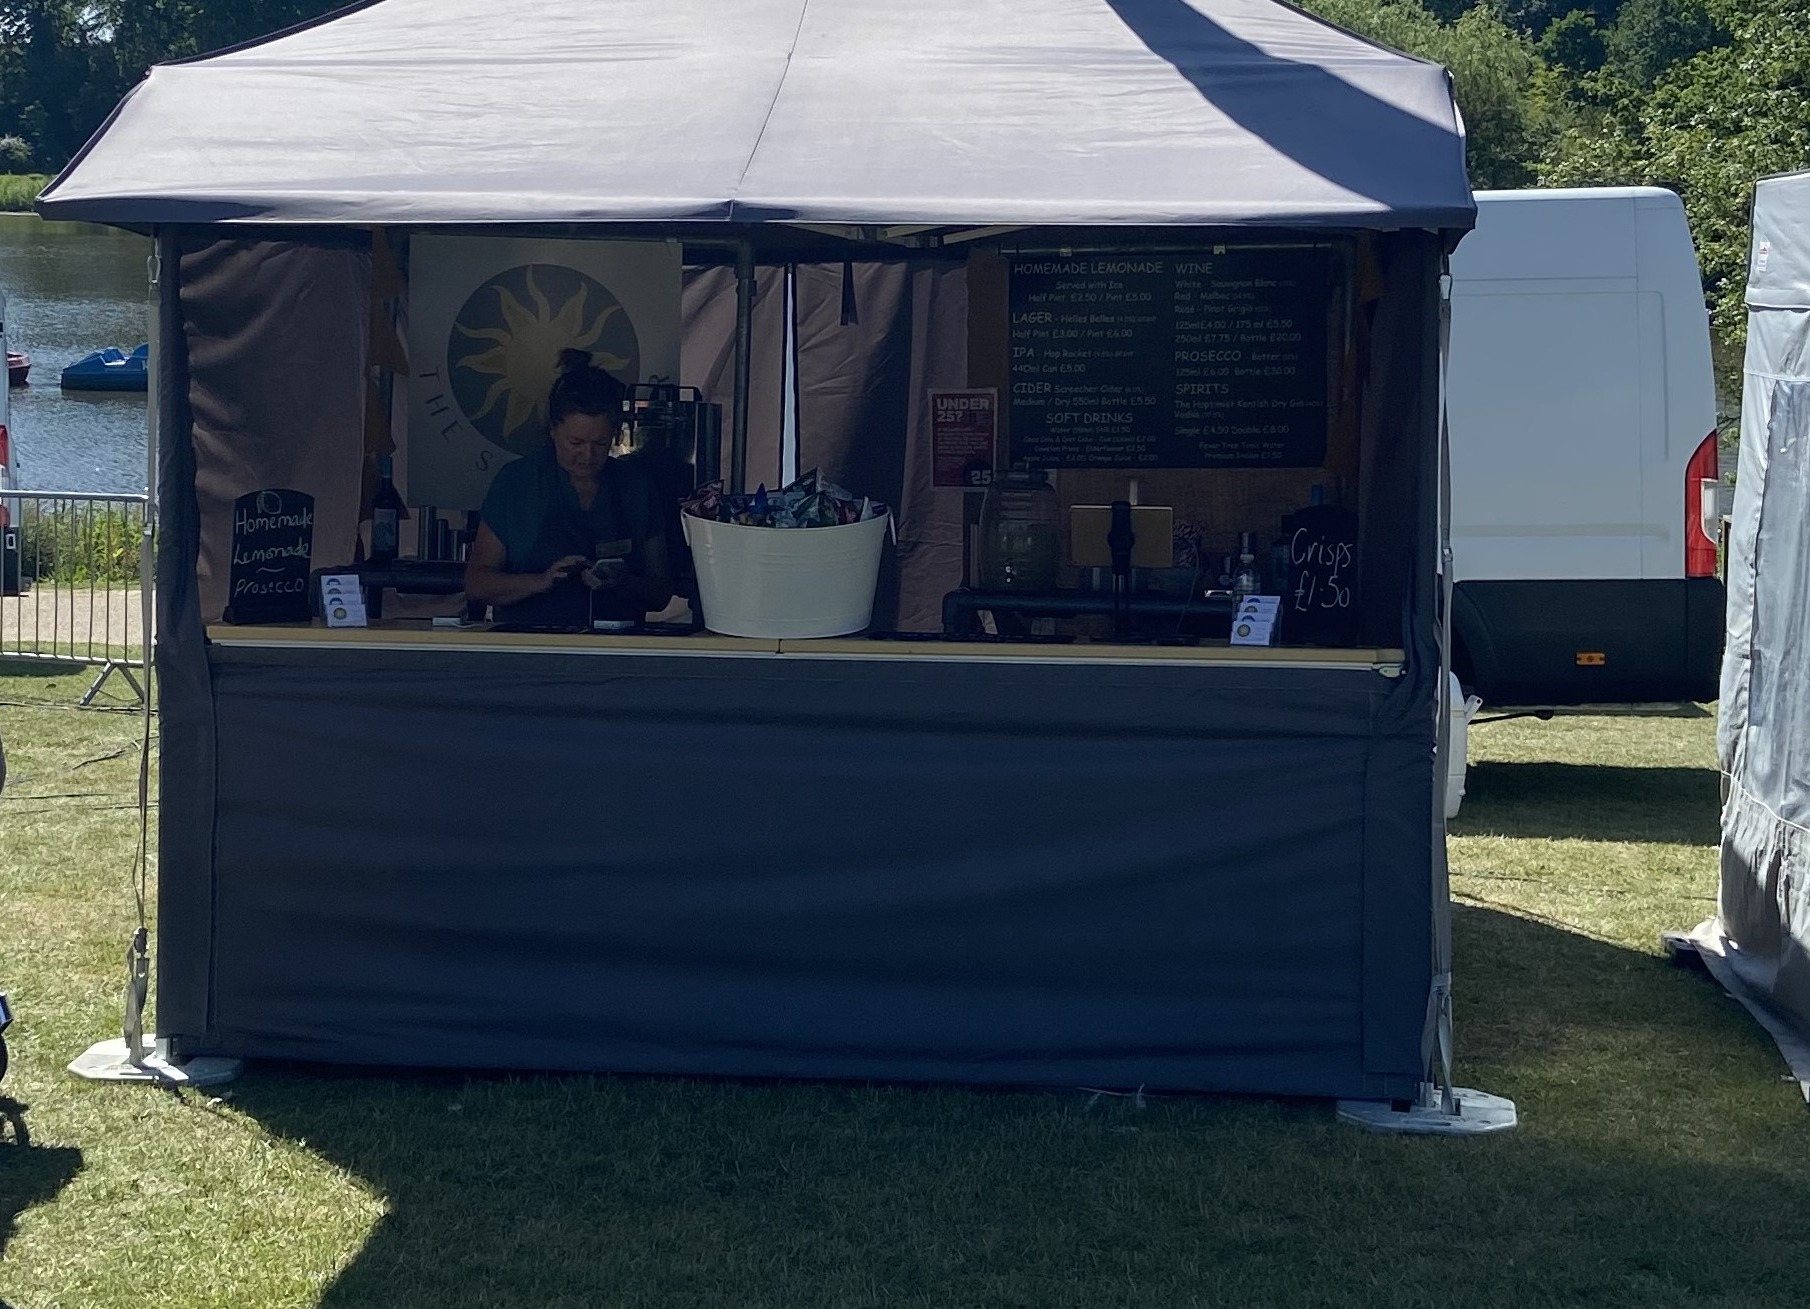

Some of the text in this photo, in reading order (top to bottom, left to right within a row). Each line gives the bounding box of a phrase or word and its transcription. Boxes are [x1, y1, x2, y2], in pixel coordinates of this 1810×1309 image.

[1014, 262, 1163, 274] HOMEMADE LEMONADE
[1175, 262, 1213, 274] WINE
[1056, 280, 1123, 290] Served with Ice
[1174, 280, 1201, 289] White
[1255, 277, 1277, 287] Blanc
[1028, 293, 1047, 302] Half
[1070, 293, 1097, 302] £2.50
[1105, 293, 1123, 301] Pint
[1125, 292, 1152, 302] £5.00
[1174, 292, 1191, 300] Red
[1200, 292, 1230, 300] Malbec
[1204, 305, 1225, 313] Pinot
[1012, 312, 1052, 323] LAGER
[1236, 320, 1251, 329] 175
[1253, 320, 1264, 329] ml
[1266, 319, 1293, 329] £5.50
[1012, 330, 1031, 339] Half
[1033, 329, 1049, 338] Pint
[1052, 329, 1078, 339] £3.00
[1087, 329, 1104, 338] Pint
[1204, 333, 1230, 343] £7.75
[1240, 333, 1266, 342] Bottle
[1012, 347, 1035, 358] IPA
[1044, 349, 1058, 359] Hop
[1063, 348, 1092, 358] Rocket
[1175, 350, 1242, 362] PROSECCO
[1042, 364, 1057, 372] Can
[1060, 363, 1086, 373] £5.00
[1234, 366, 1262, 376] Bottle
[1013, 382, 1051, 394] CIDER
[1100, 384, 1123, 393] Cider
[1175, 383, 1229, 394] SPIRITS
[419, 366, 463, 441] THE
[936, 398, 990, 410] UNDER
[1013, 397, 1046, 406] Medium
[1055, 398, 1070, 407] Dry
[1101, 397, 1128, 406] Bottle
[1130, 396, 1157, 406] £5.50
[1174, 400, 1190, 409] The
[1272, 399, 1287, 409] Dry
[937, 411, 963, 422] 25?
[1045, 412, 1134, 424] SOFT DRINKS
[1174, 410, 1200, 419] Vodka
[1231, 425, 1261, 434] Double
[970, 470, 992, 484] 25
[235, 507, 313, 535] Homemade
[233, 536, 312, 565] Lemonade
[1291, 528, 1353, 578] Crisps
